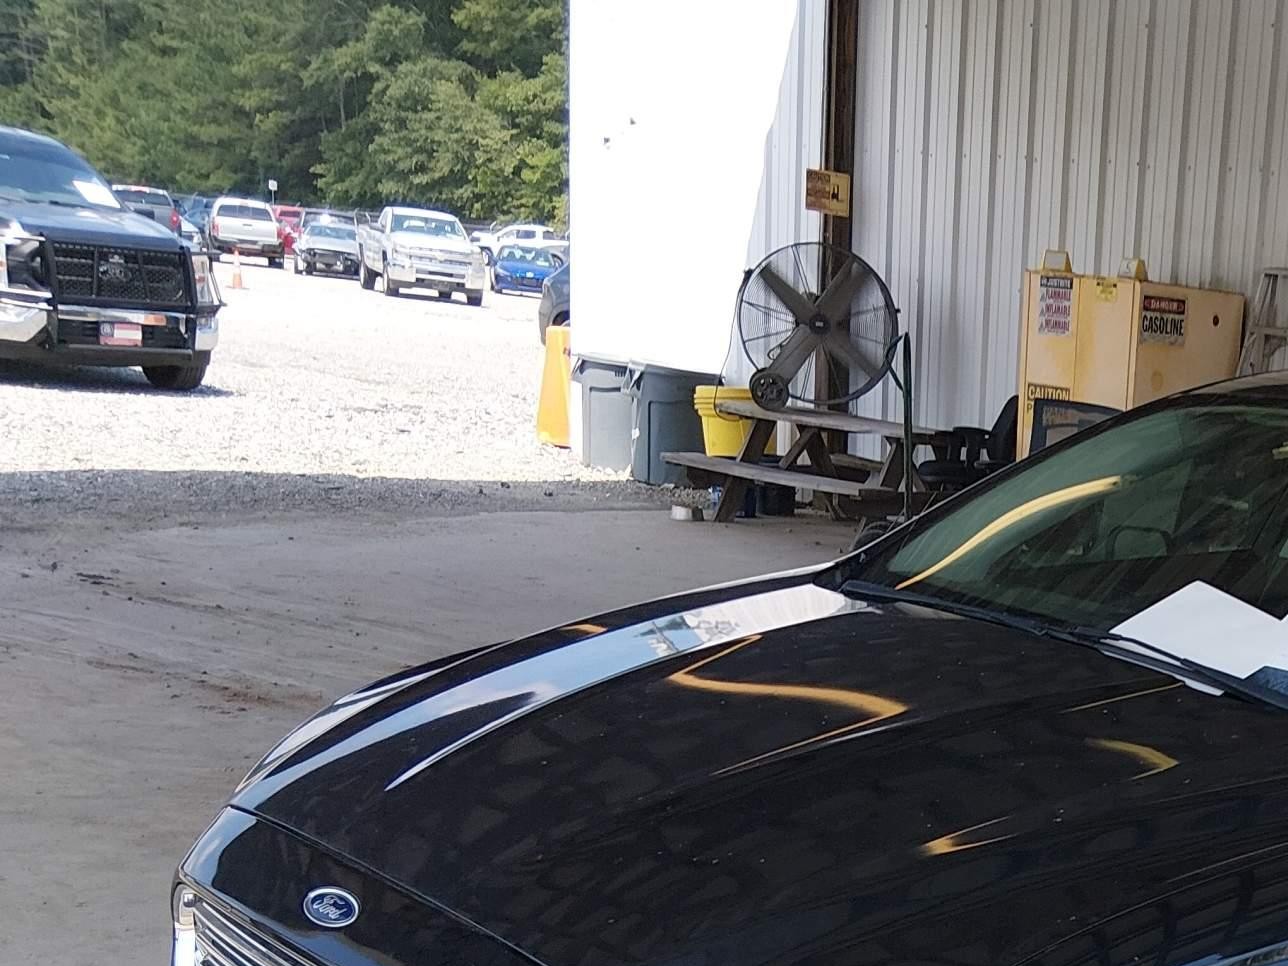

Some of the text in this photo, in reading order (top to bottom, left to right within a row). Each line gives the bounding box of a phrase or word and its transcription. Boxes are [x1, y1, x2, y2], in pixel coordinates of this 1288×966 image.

[1142, 314, 1185, 337] GASOLINE
[1028, 385, 1070, 400] CAUTION
[312, 894, 348, 919] Ford
